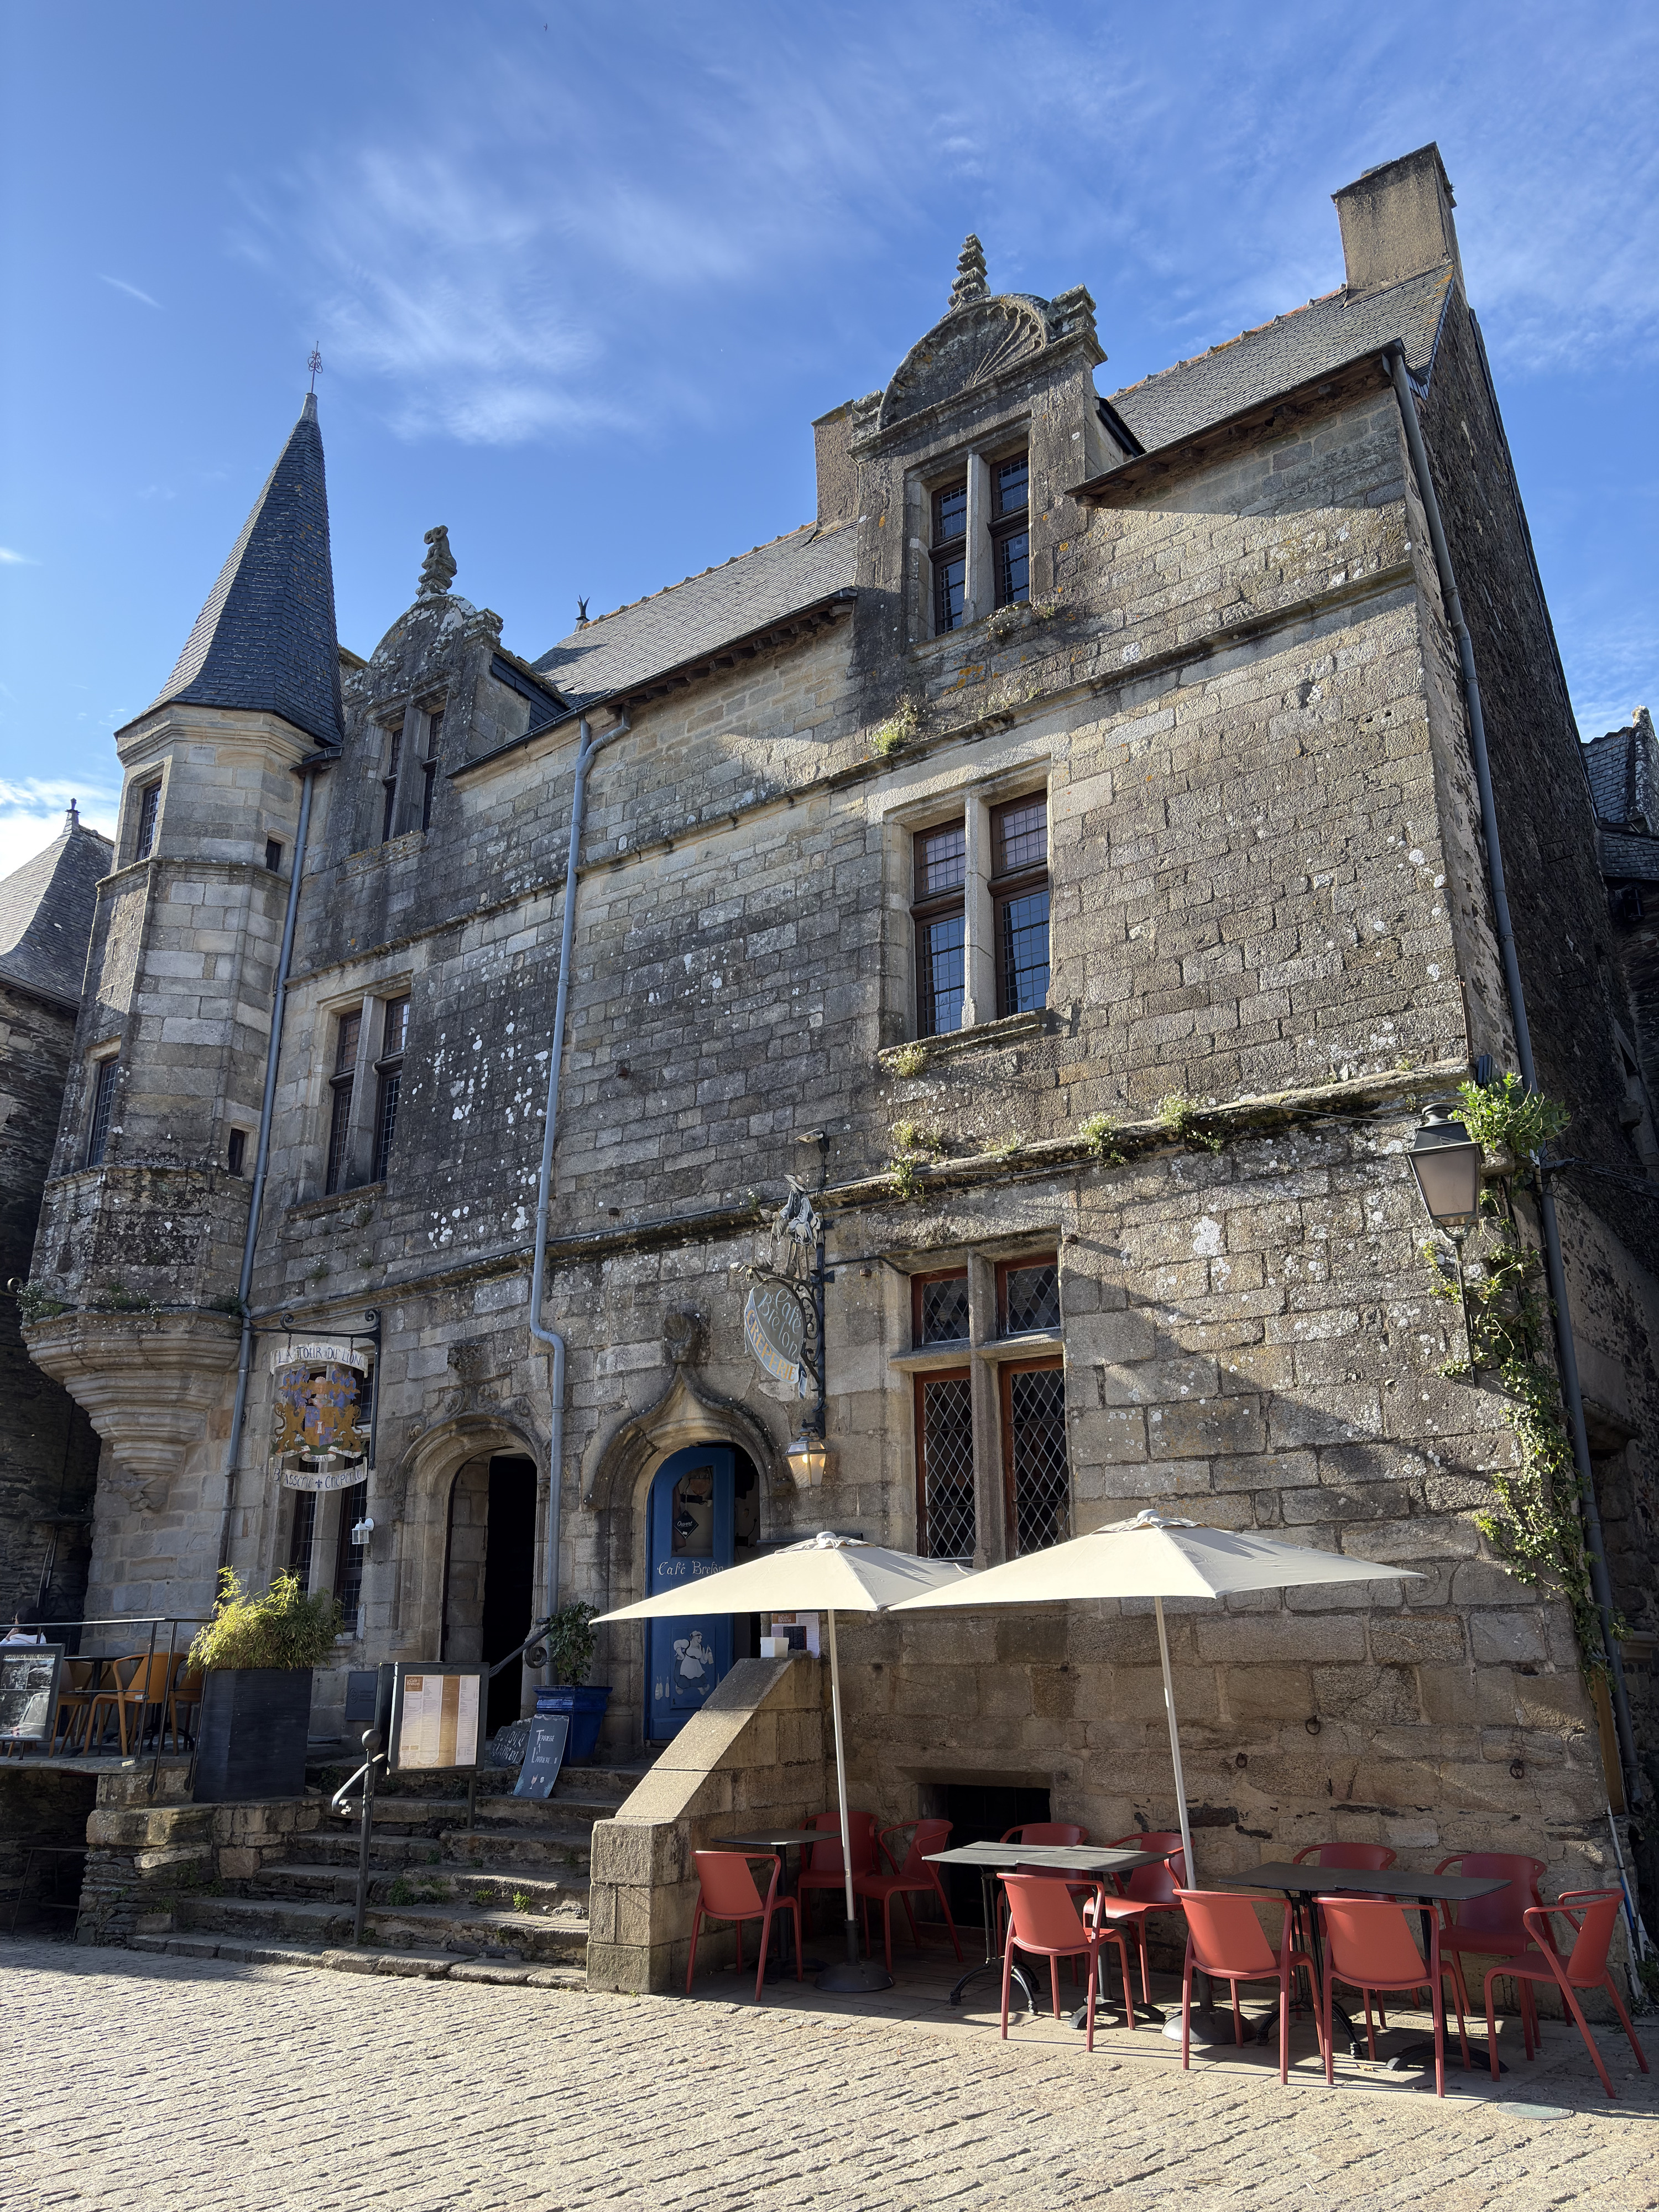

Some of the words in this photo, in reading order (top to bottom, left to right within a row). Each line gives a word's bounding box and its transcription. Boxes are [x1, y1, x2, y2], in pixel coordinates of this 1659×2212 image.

[772, 1288, 801, 1334] Café
[278, 1350, 292, 1364] LA
[296, 1347, 322, 1359] TOUR
[327, 1347, 338, 1359] DU
[342, 1348, 362, 1366] LION
[657, 1562, 686, 1575] Café
